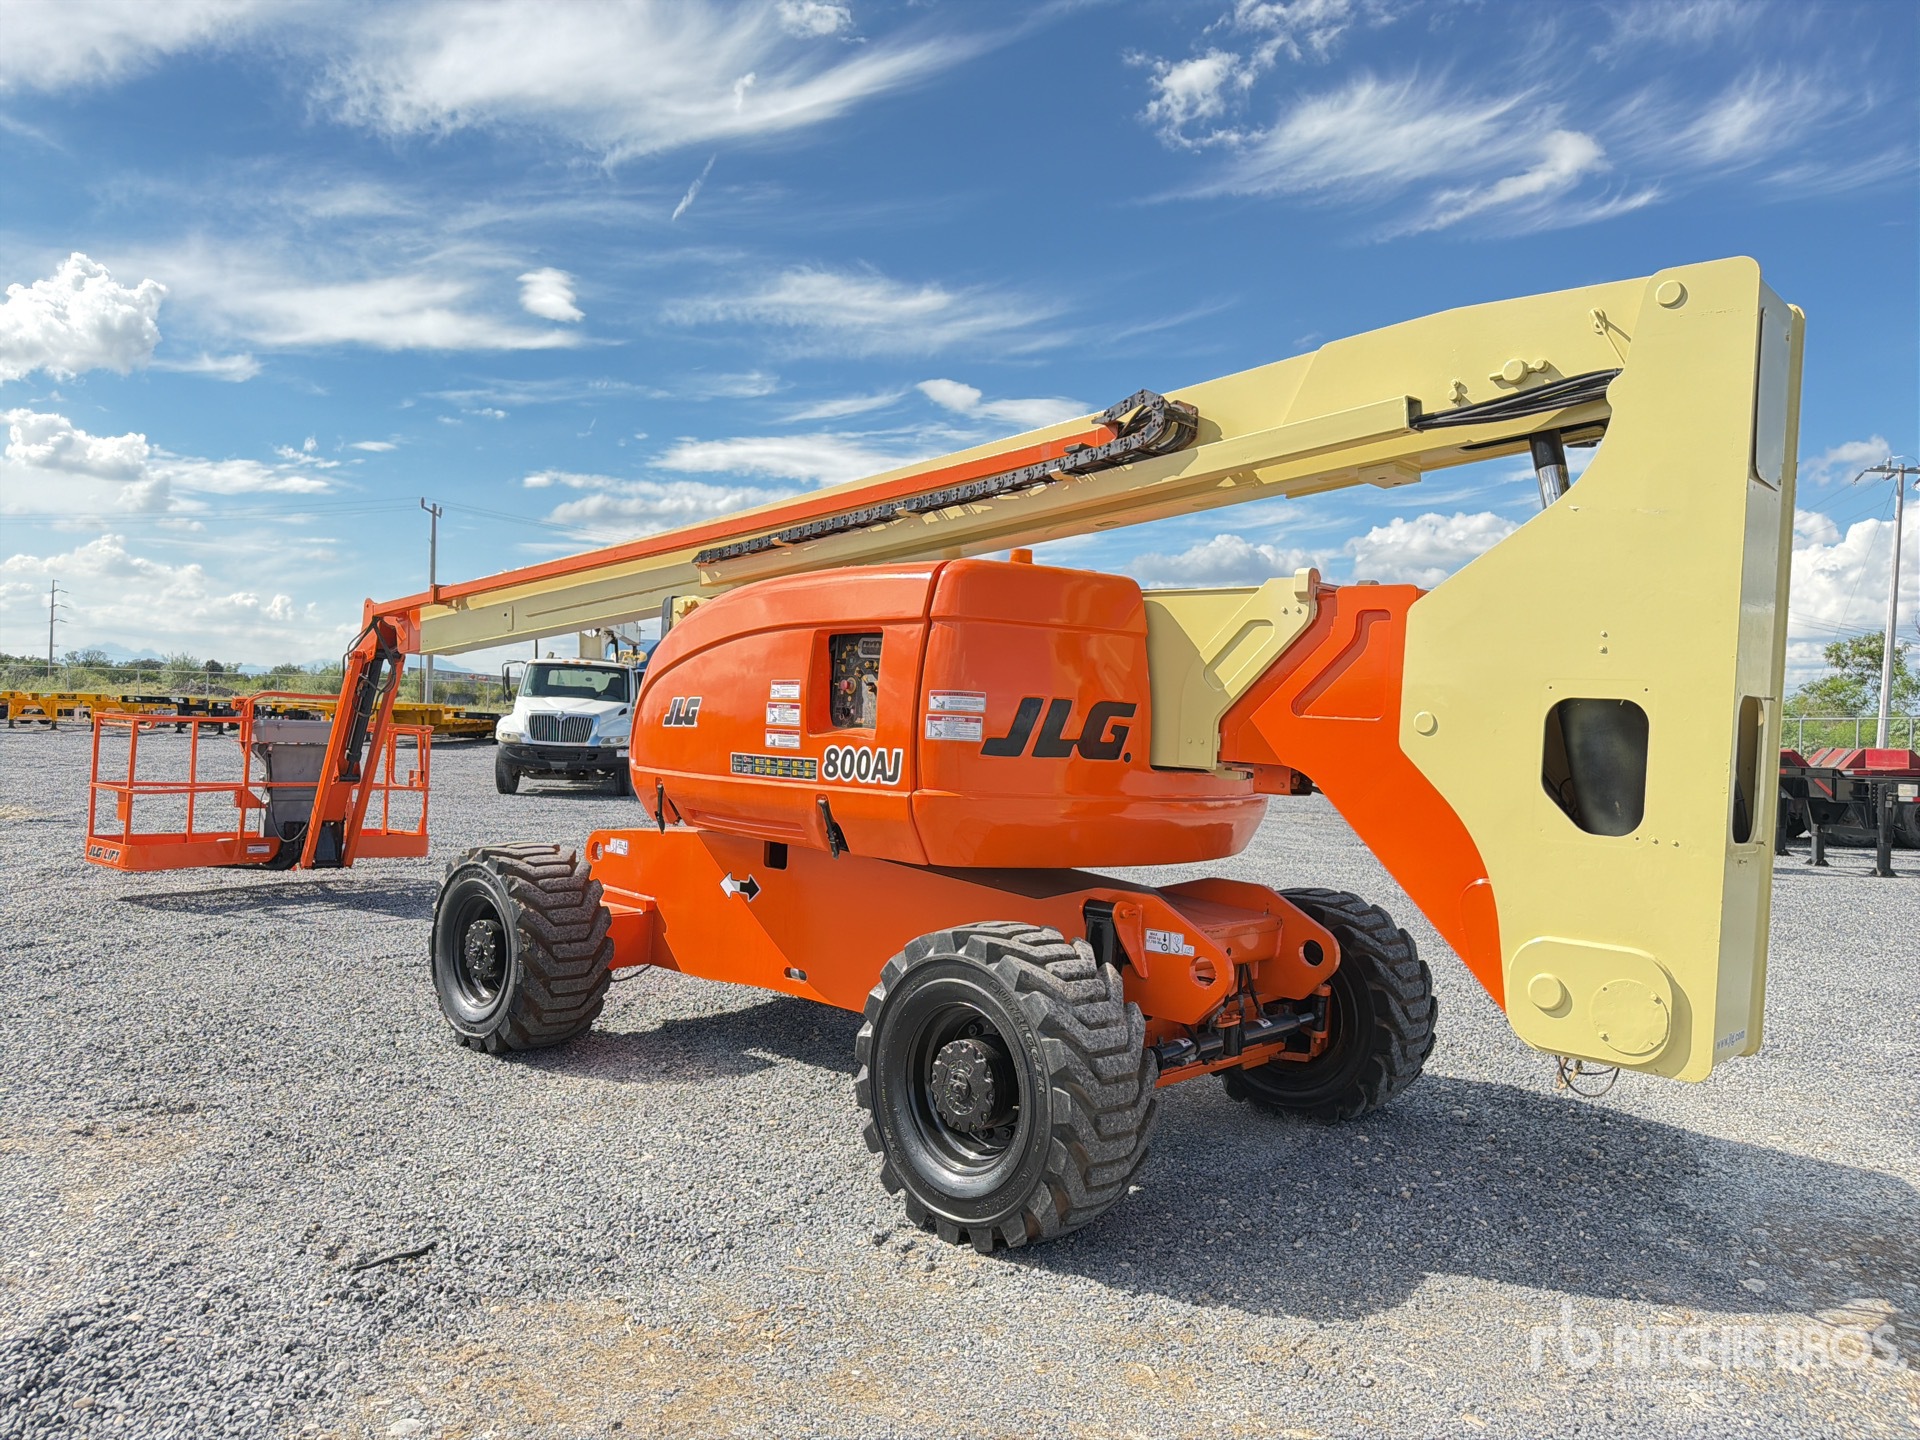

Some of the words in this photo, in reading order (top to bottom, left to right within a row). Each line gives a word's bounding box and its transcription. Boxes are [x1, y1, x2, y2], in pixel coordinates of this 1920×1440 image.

[663, 697, 701, 727] JLG
[823, 746, 903, 784] 800AJ
[88, 846, 103, 858] JLG
[103, 848, 120, 861] LIFT
[988, 980, 1046, 1095] OUTRIGGER
